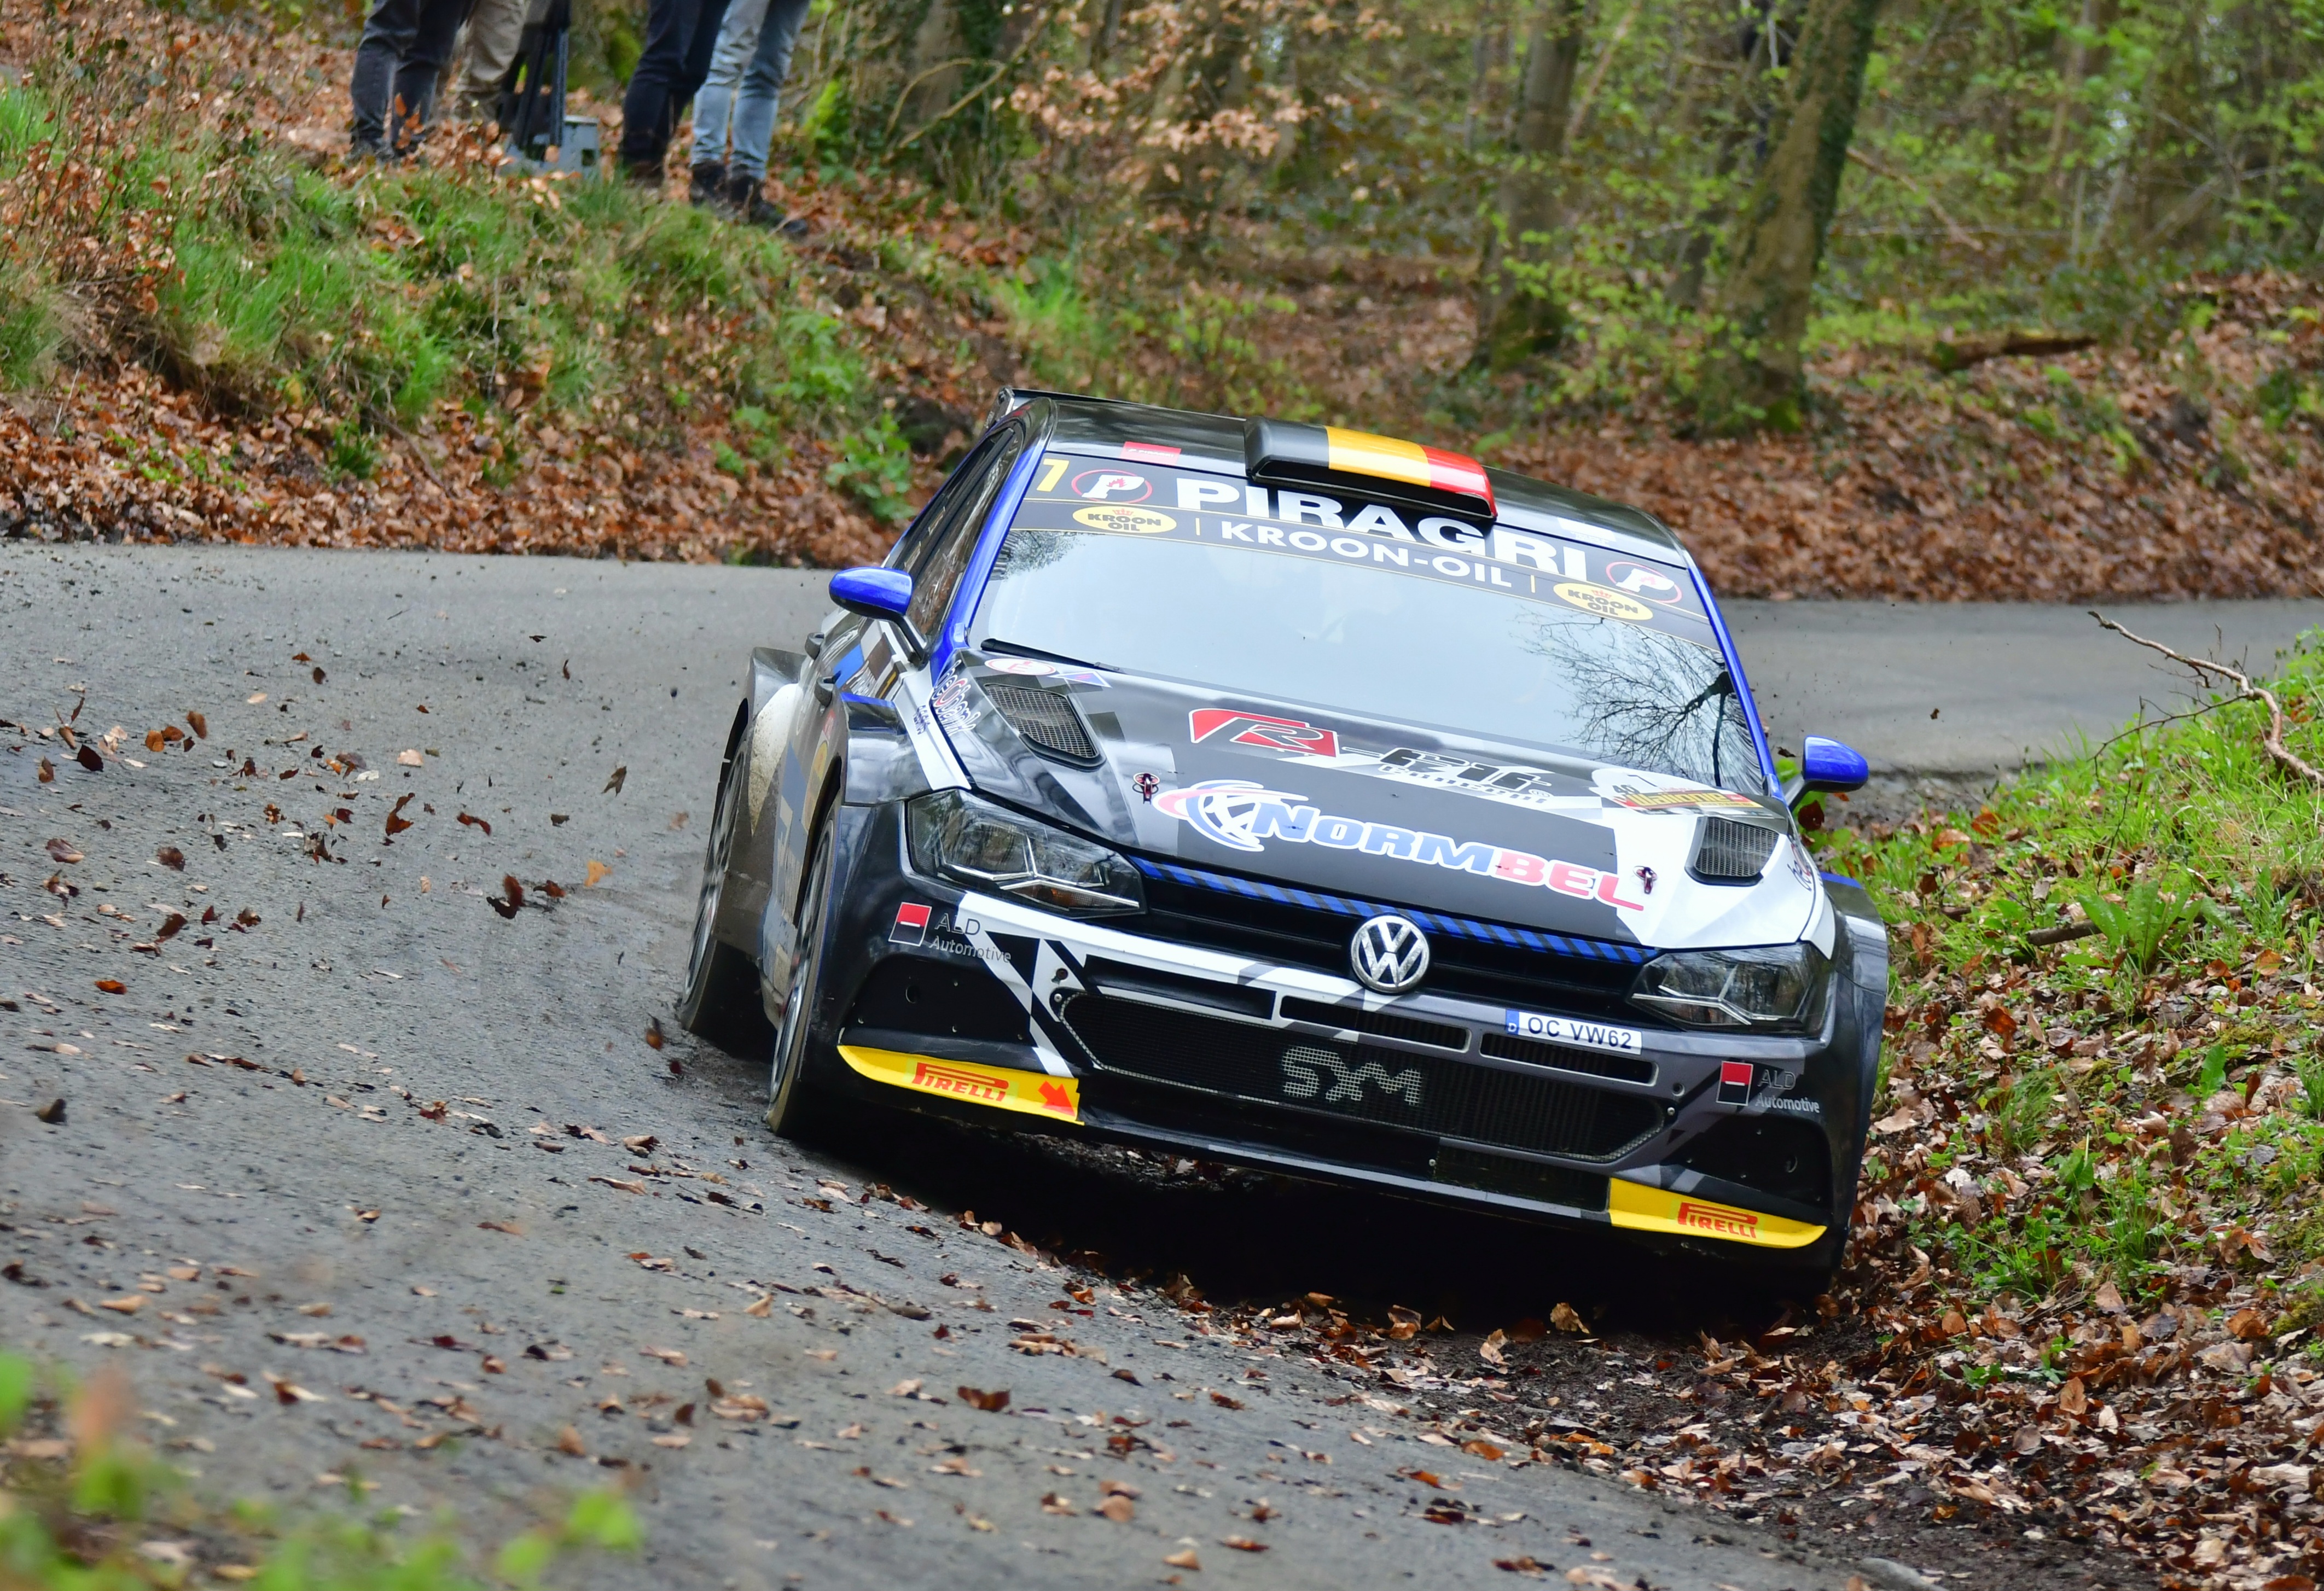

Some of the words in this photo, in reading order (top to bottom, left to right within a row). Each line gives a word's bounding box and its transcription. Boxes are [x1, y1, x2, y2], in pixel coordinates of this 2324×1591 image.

[1087, 513, 1161, 526] KROON
[1108, 521, 1141, 532] OIL
[1176, 477, 1588, 581] PIRAGRI
[1221, 520, 1512, 588] KROON-OIL
[1567, 588, 1639, 615] KROON
[1587, 601, 1619, 616] OIL
[1626, 792, 1732, 806] Wallonie
[934, 912, 981, 936] ALD
[928, 935, 1012, 964] Automotive
[1527, 1017, 1560, 1038] OC
[1570, 1022, 1632, 1050] VW62
[911, 1062, 1009, 1102] PIRELLI
[1282, 1045, 1422, 1106] SXM
[1757, 1069, 1797, 1091] ALD
[1754, 1093, 1821, 1114] Automotive
[1677, 1202, 1759, 1239] PIRELLI
